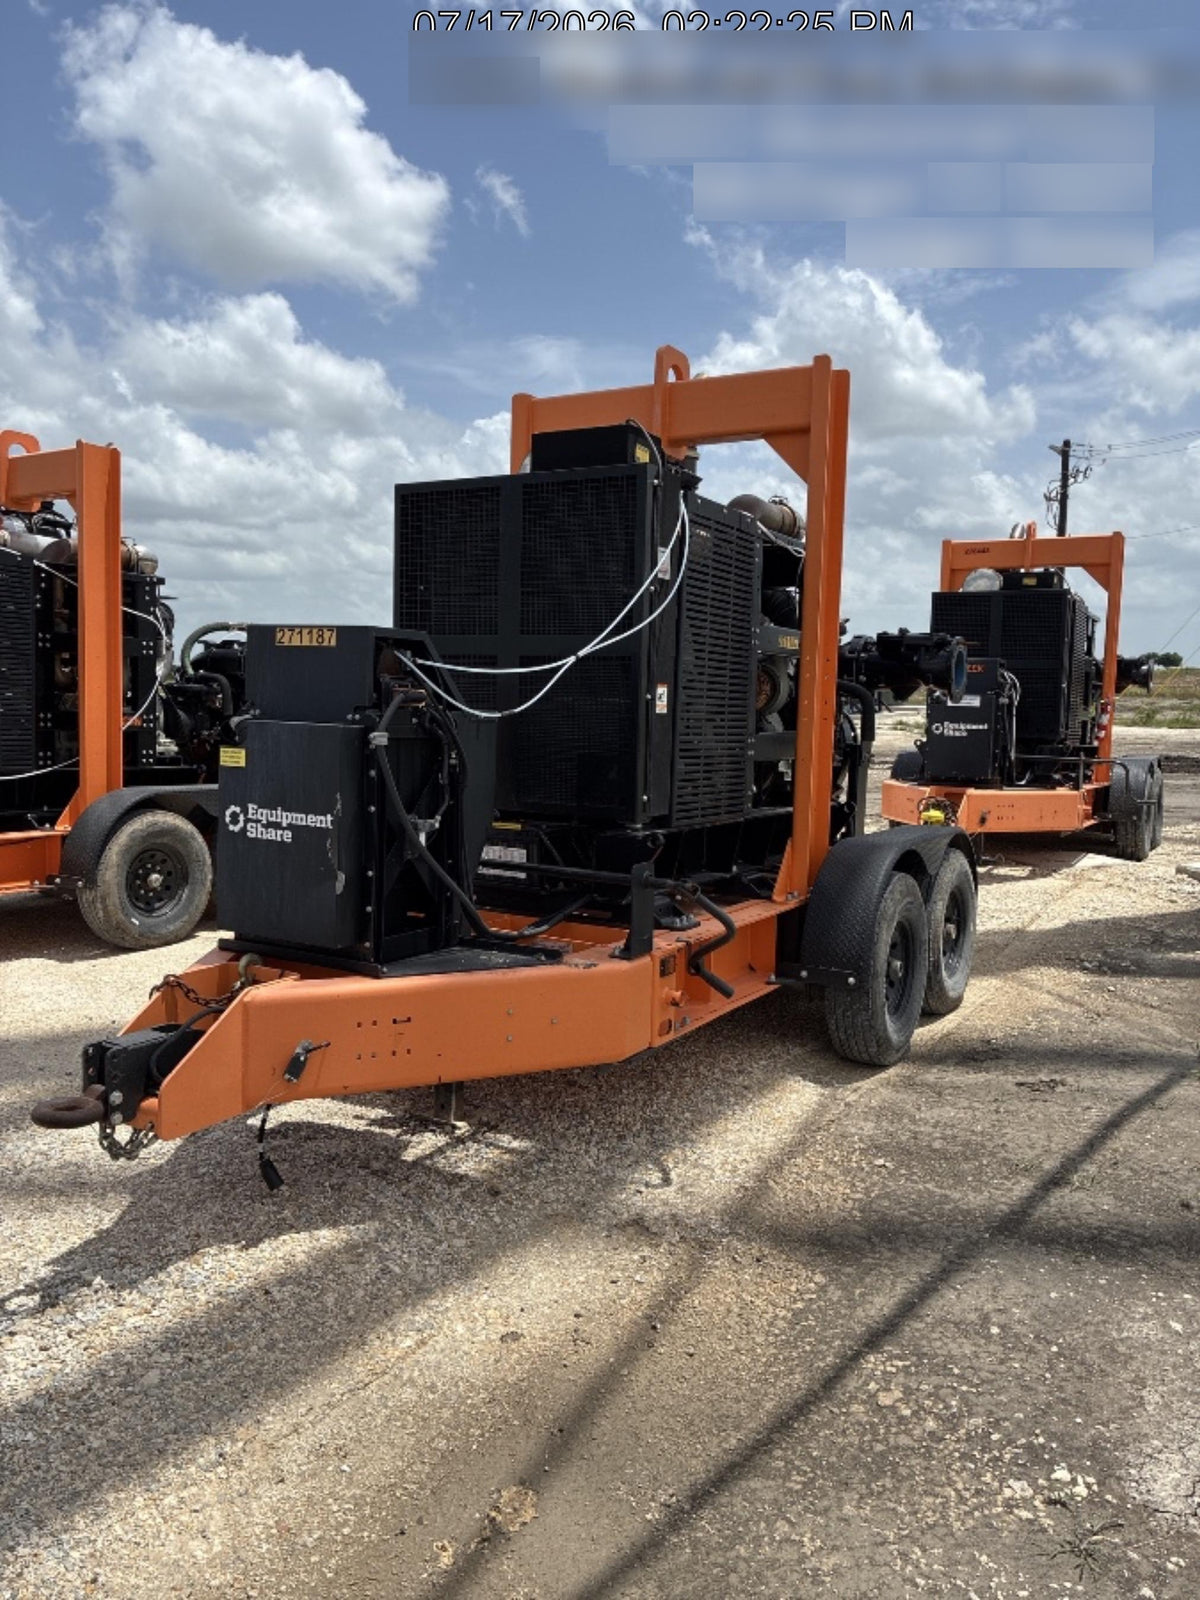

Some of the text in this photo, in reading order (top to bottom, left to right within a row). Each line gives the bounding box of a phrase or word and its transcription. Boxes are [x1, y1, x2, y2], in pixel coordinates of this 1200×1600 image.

[276, 628, 335, 644] 271187
[247, 803, 334, 829] Equipment
[246, 822, 292, 843] Share
